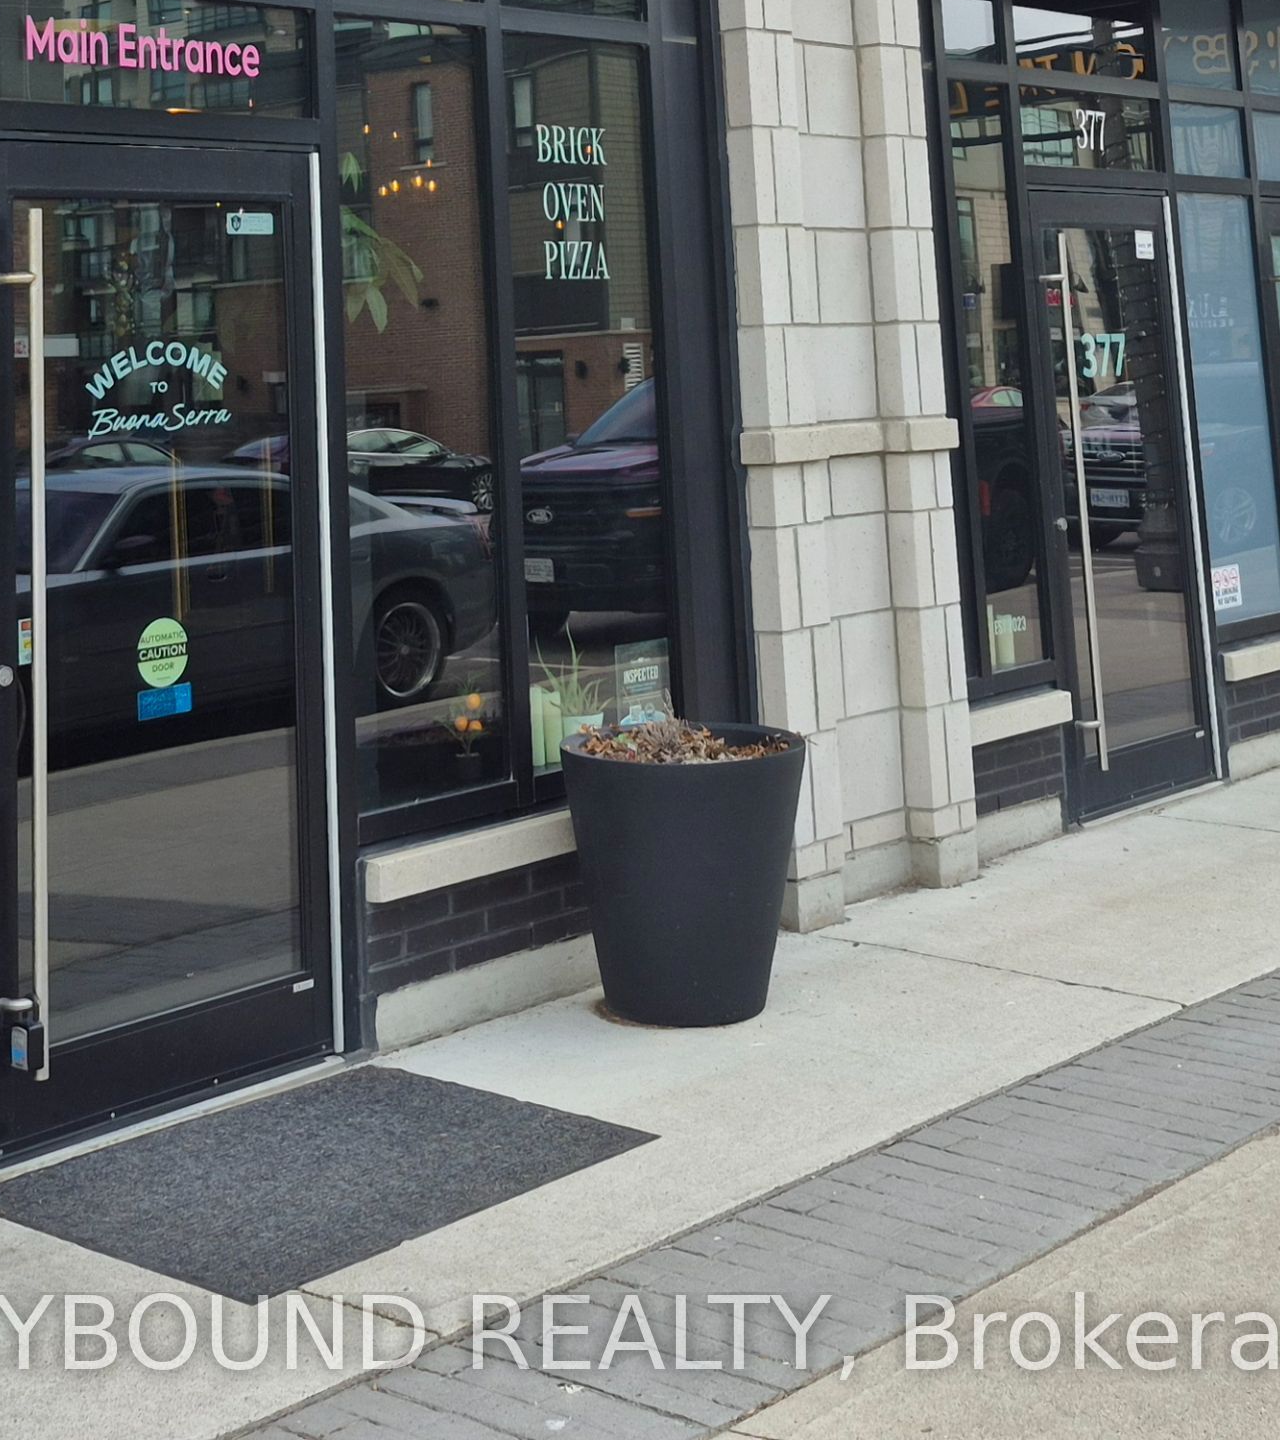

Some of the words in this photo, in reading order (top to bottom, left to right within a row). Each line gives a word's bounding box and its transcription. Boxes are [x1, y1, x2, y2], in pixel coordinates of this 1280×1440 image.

[25, 14, 109, 70] Main
[117, 22, 261, 79] Entrance
[536, 123, 608, 166] BRICK
[1075, 108, 1107, 152] 377
[542, 181, 606, 223] OVEN
[544, 240, 610, 281] PIZZA
[84, 340, 228, 400] WELCOME
[1081, 332, 1127, 379] 377
[149, 380, 169, 394] TO
[88, 407, 169, 441] Buona
[163, 402, 232, 432] Serra
[138, 643, 187, 661] CAUTION
[140, 630, 185, 645] AUTOMATIC
[151, 661, 175, 673] DOOR
[623, 664, 659, 685] INSPECTED
